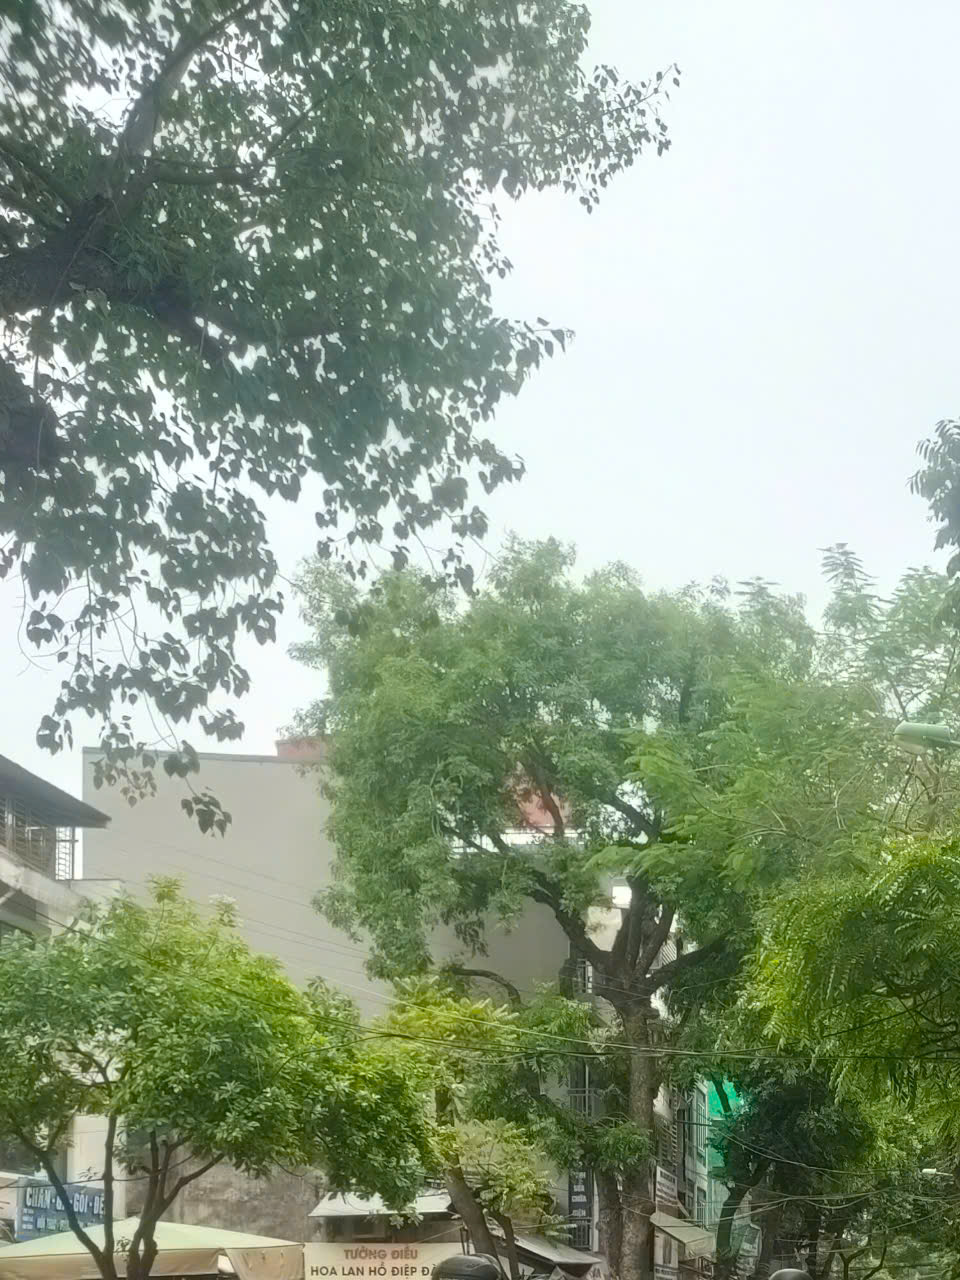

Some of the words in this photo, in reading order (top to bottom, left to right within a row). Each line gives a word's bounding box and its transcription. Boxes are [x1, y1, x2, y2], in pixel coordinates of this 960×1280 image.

[311, 1266, 338, 1276] HOA
[342, 1266, 365, 1276] LAN
[391, 1264, 417, 1279] ĐIỆP
